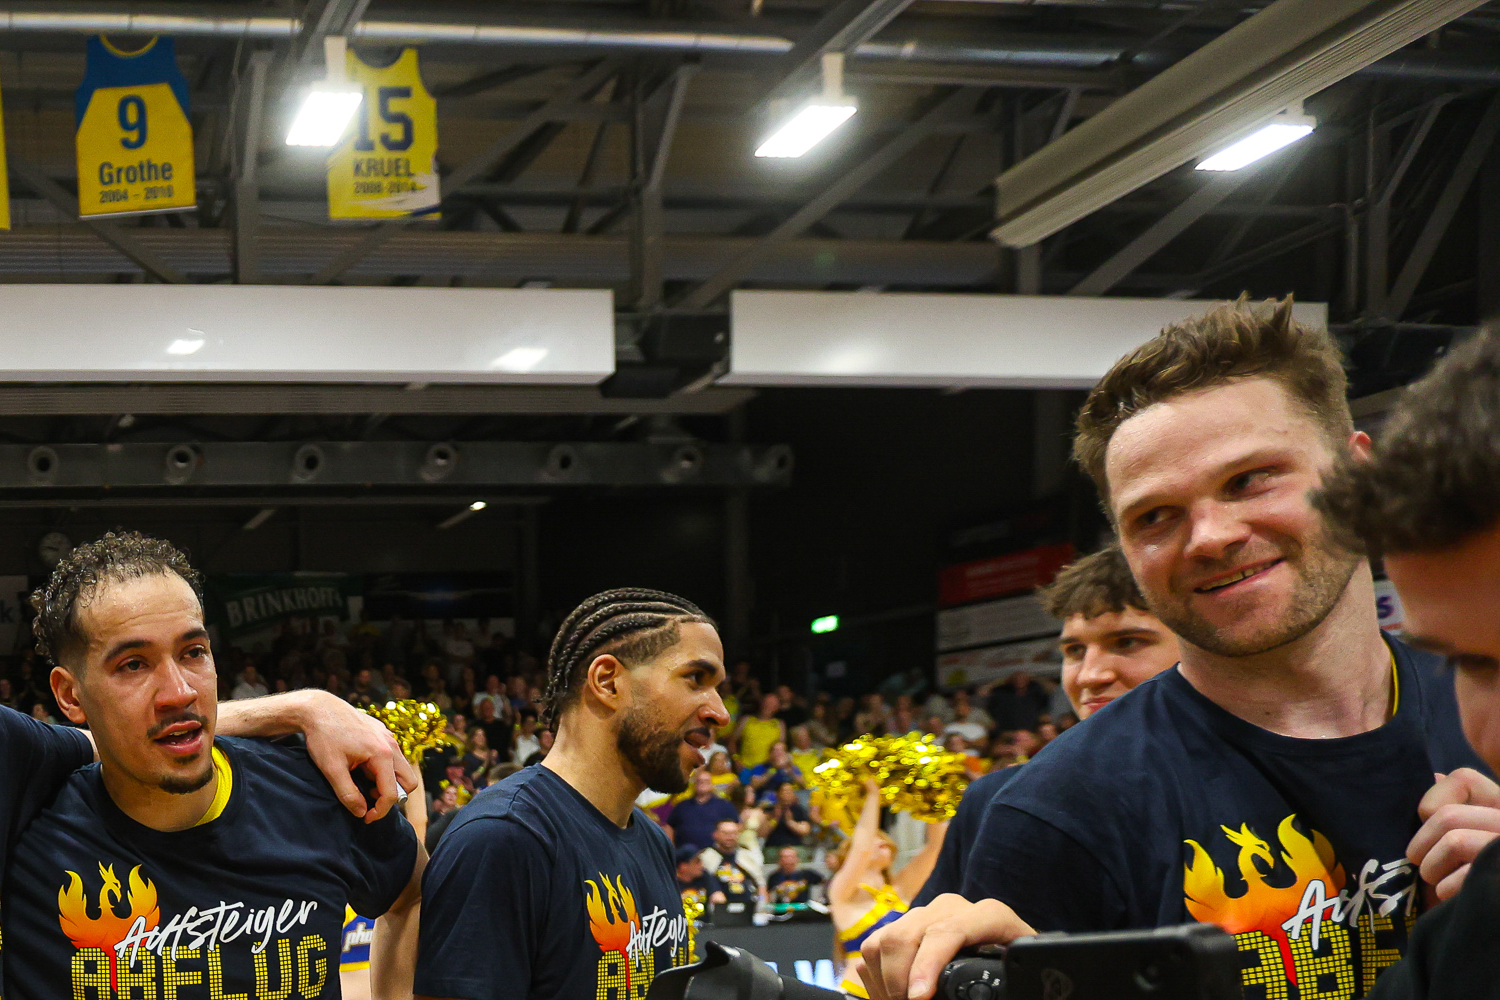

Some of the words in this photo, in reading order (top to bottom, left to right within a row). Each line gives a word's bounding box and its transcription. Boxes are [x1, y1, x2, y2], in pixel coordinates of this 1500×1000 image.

[117, 94, 148, 150] 9
[354, 86, 414, 151] 15
[99, 158, 174, 187] Grothe
[113, 898, 319, 969] Aufsteiger
